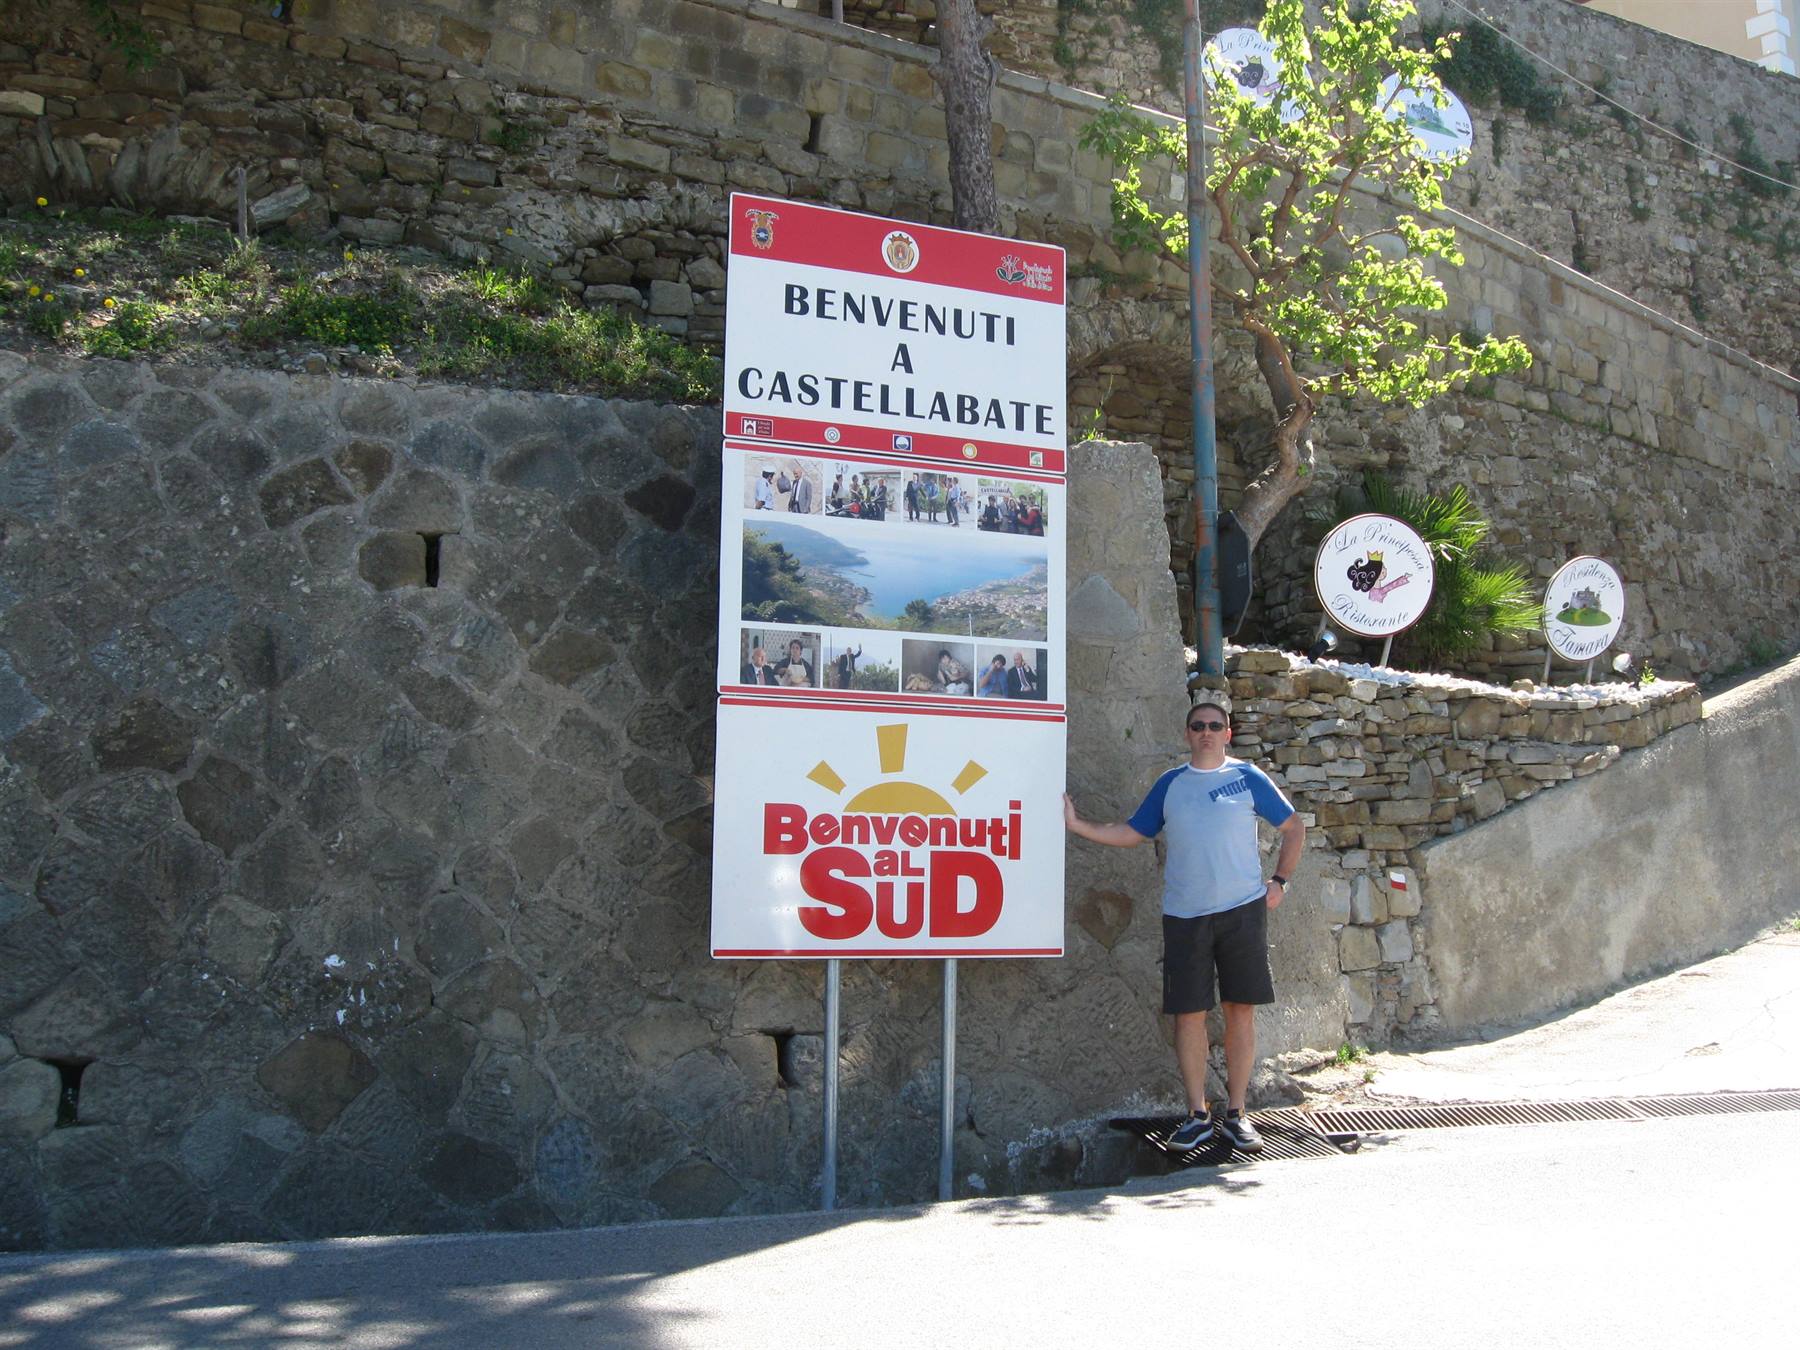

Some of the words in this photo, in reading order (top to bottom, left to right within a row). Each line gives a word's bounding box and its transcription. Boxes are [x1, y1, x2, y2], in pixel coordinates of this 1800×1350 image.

[784, 283, 1015, 346] BENVENUTI
[891, 342, 914, 374] A
[737, 367, 1055, 435] CASTELLABATE
[1334, 527, 1358, 554] La
[1363, 522, 1425, 570] Principessa
[1331, 593, 1409, 628] Ristorante
[1553, 626, 1609, 656] Tamara
[1208, 777, 1248, 802] PUMA
[763, 800, 1022, 861] Benvenuti
